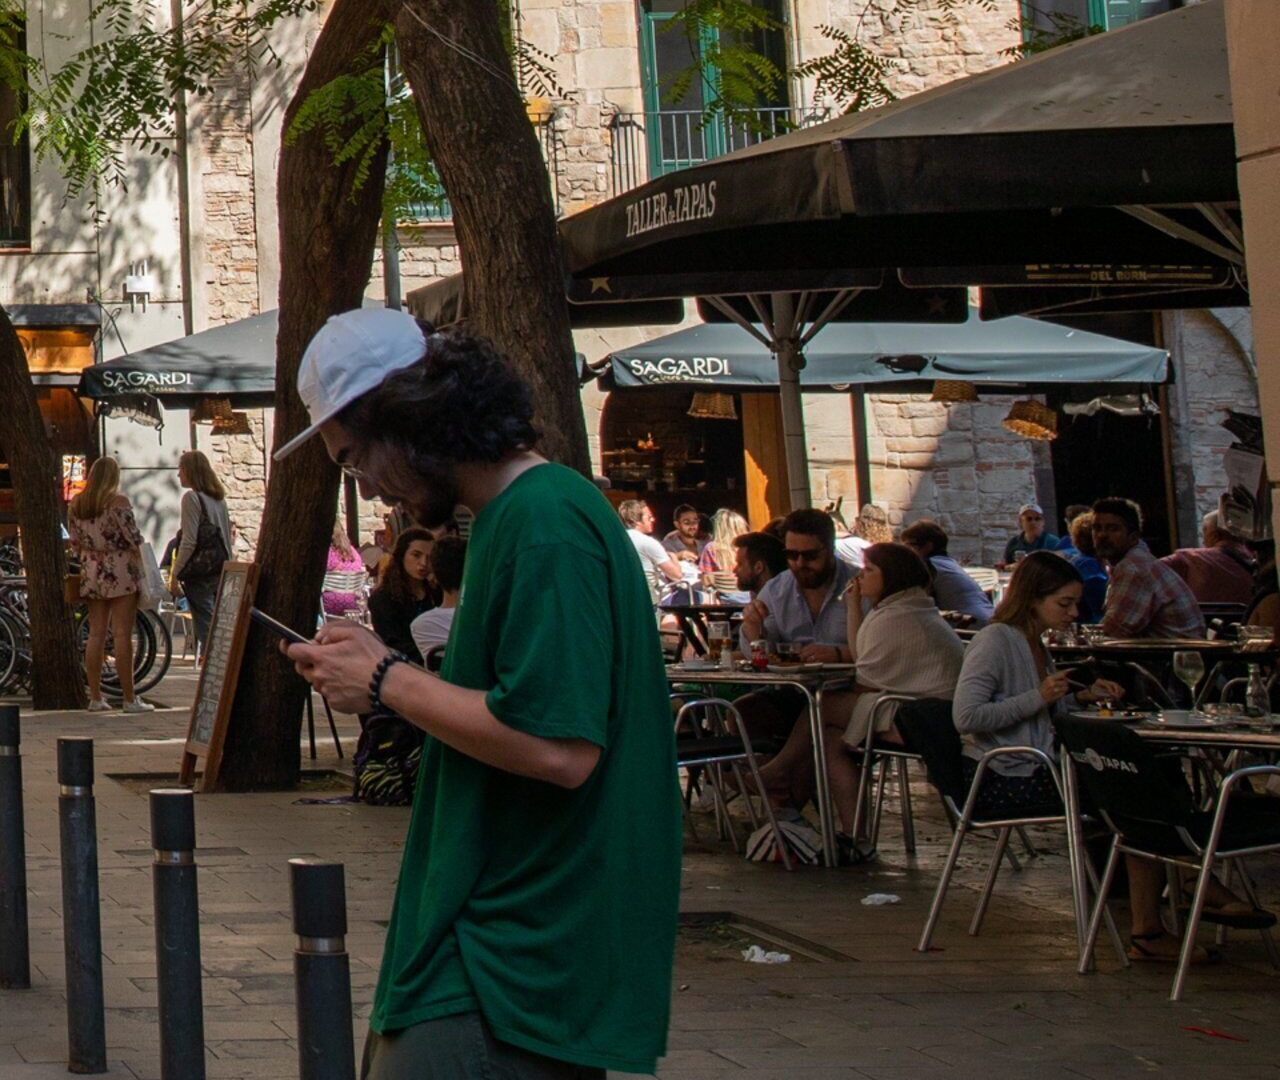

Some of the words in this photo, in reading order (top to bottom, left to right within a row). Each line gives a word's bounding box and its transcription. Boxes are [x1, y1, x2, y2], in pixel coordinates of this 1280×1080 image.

[626, 191, 669, 238] TALLER
[667, 205, 677, 224] de
[674, 180, 717, 223] TAPAS
[630, 356, 730, 377] SAGARDI
[102, 370, 194, 388] SAGARDI
[1100, 755, 1139, 774] TAPAS
